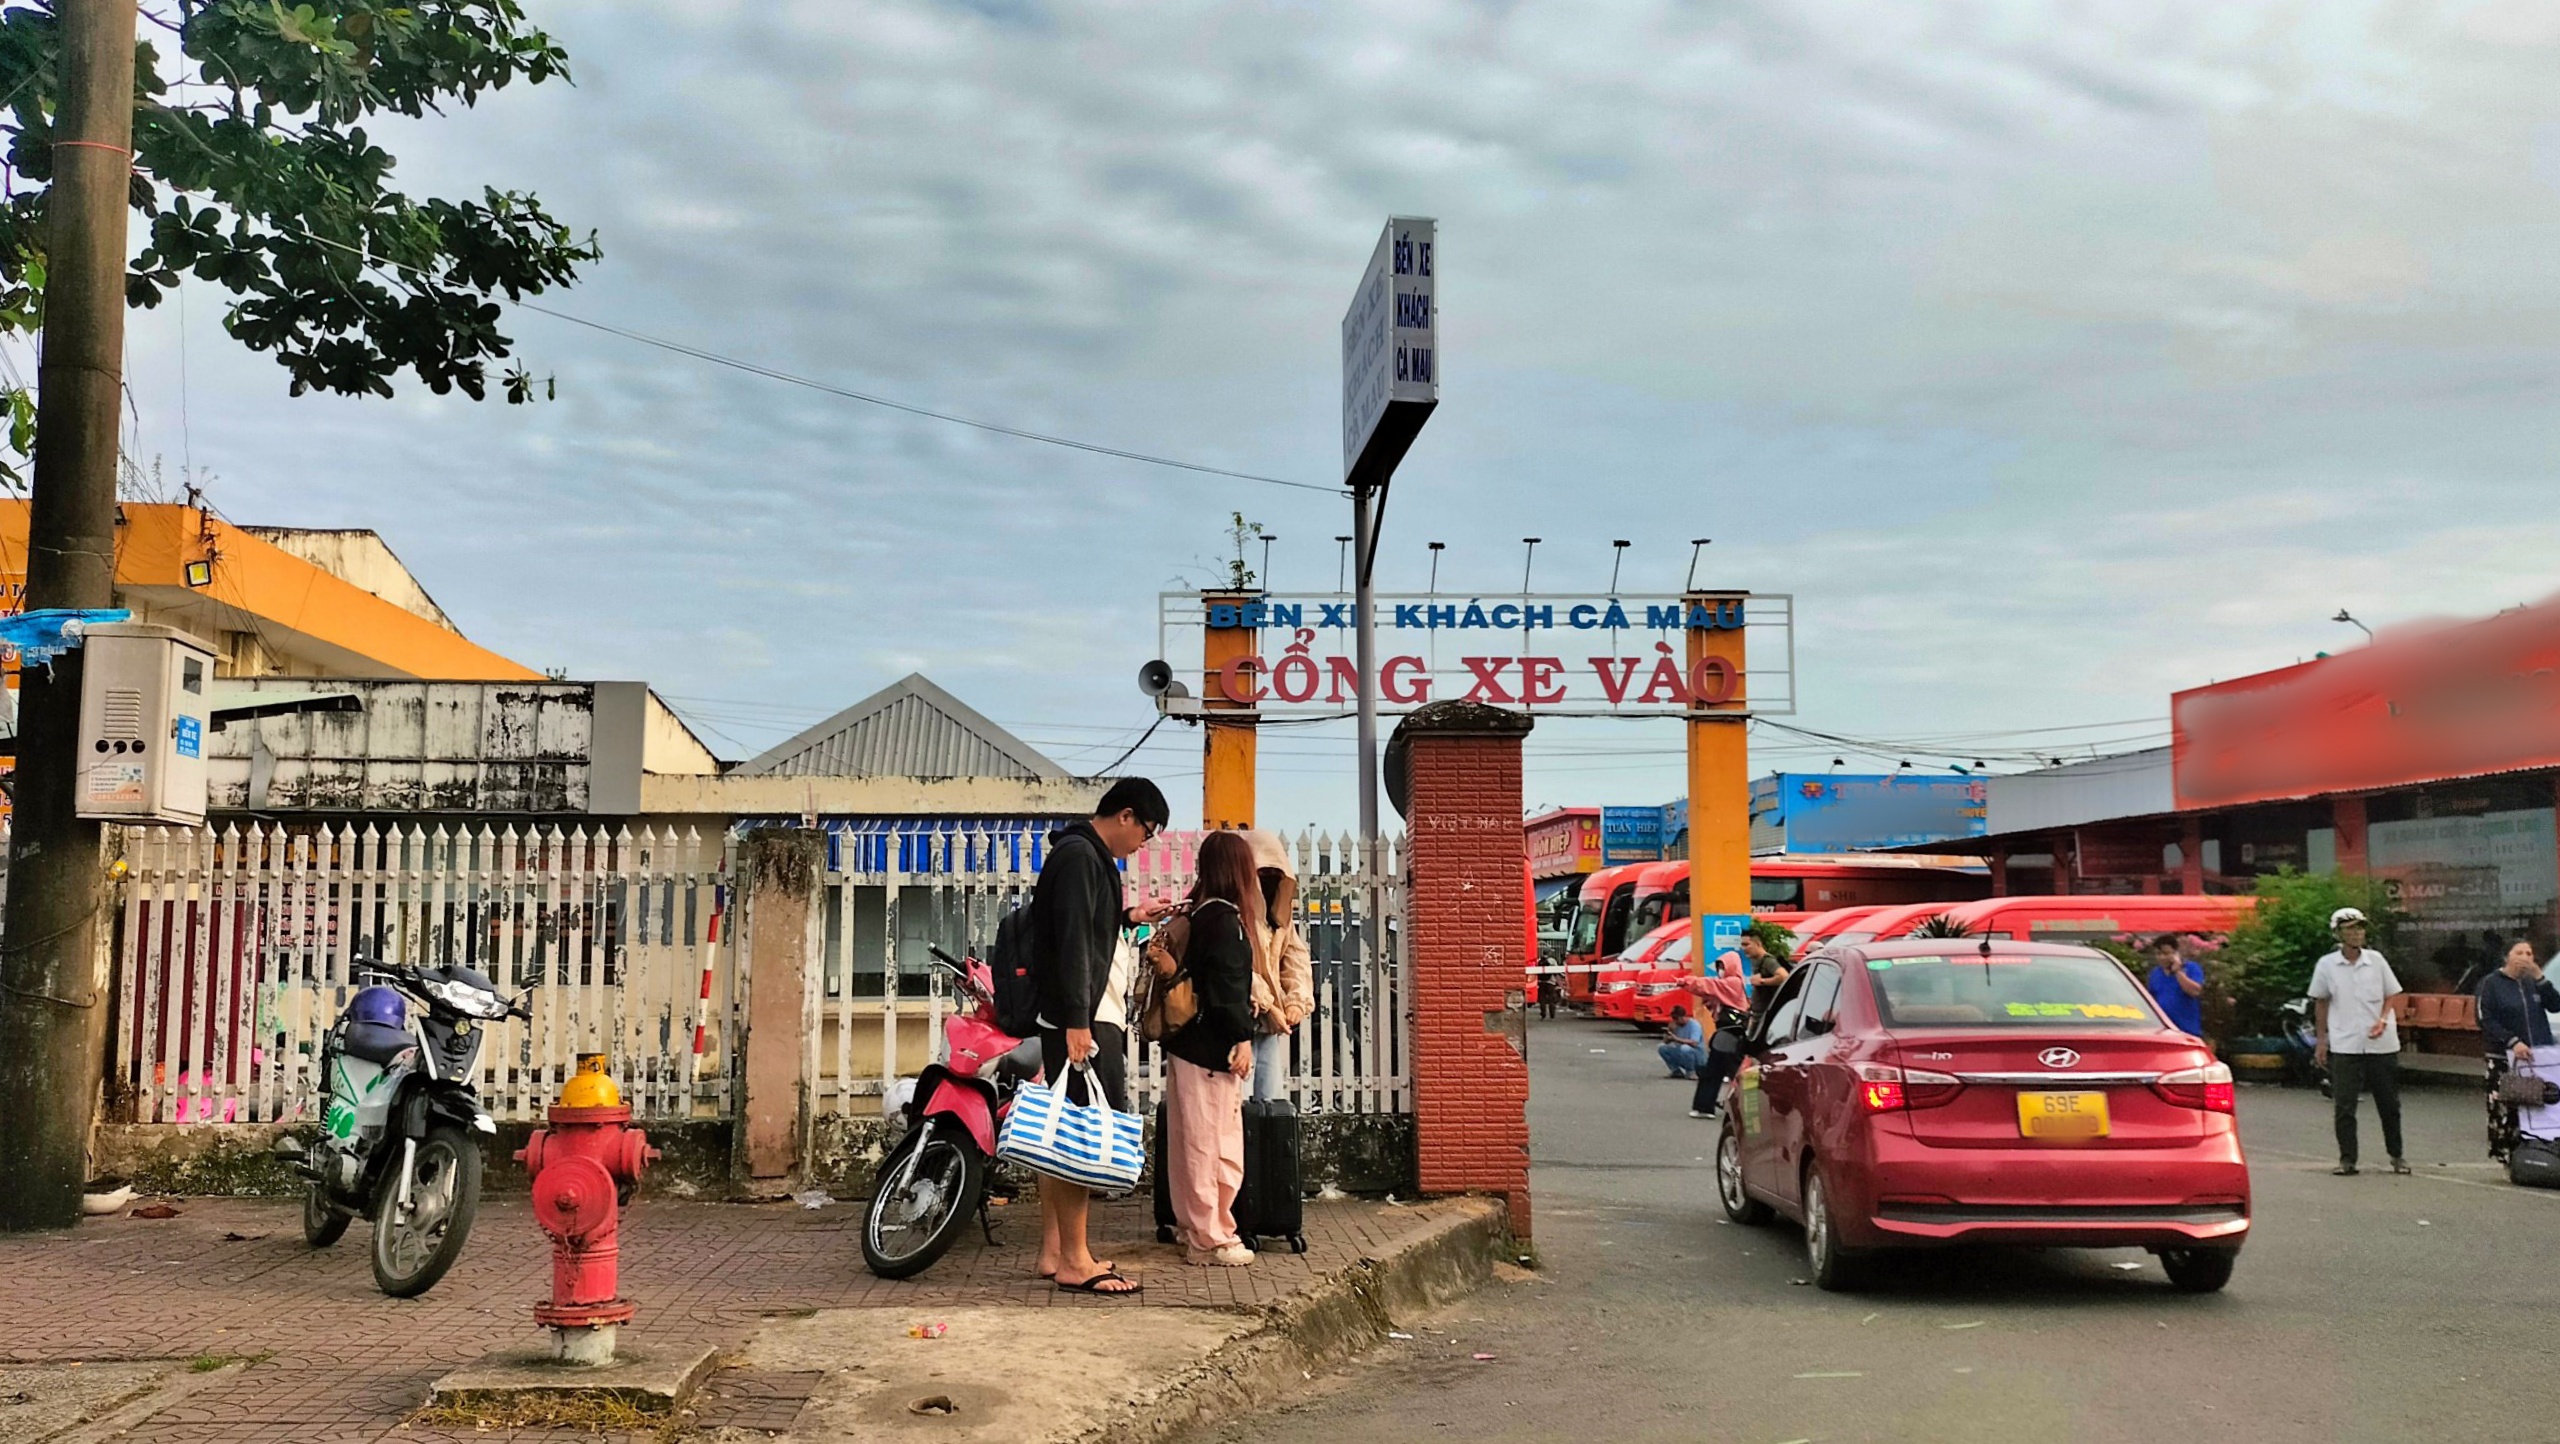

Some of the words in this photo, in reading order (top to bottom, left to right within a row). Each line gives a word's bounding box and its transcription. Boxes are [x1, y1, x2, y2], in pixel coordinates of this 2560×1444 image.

[1395, 231, 1414, 276] BẾN
[1418, 243, 1431, 277] XE
[1397, 287, 1429, 330] KHÁCH
[1397, 340, 1409, 384] CÀ
[1411, 348, 1432, 384] MAU
[1210, 594, 1302, 629] BẾN
[1395, 598, 1553, 629] KHÁCH
[1569, 598, 1630, 629] CÀ
[1646, 603, 1745, 630] MAU
[1220, 628, 1433, 704] CỔNG
[1460, 657, 1568, 704] XE
[1588, 641, 1738, 704] VÀO
[1583, 834, 1601, 850] H
[2043, 1095, 2082, 1113] 69E
